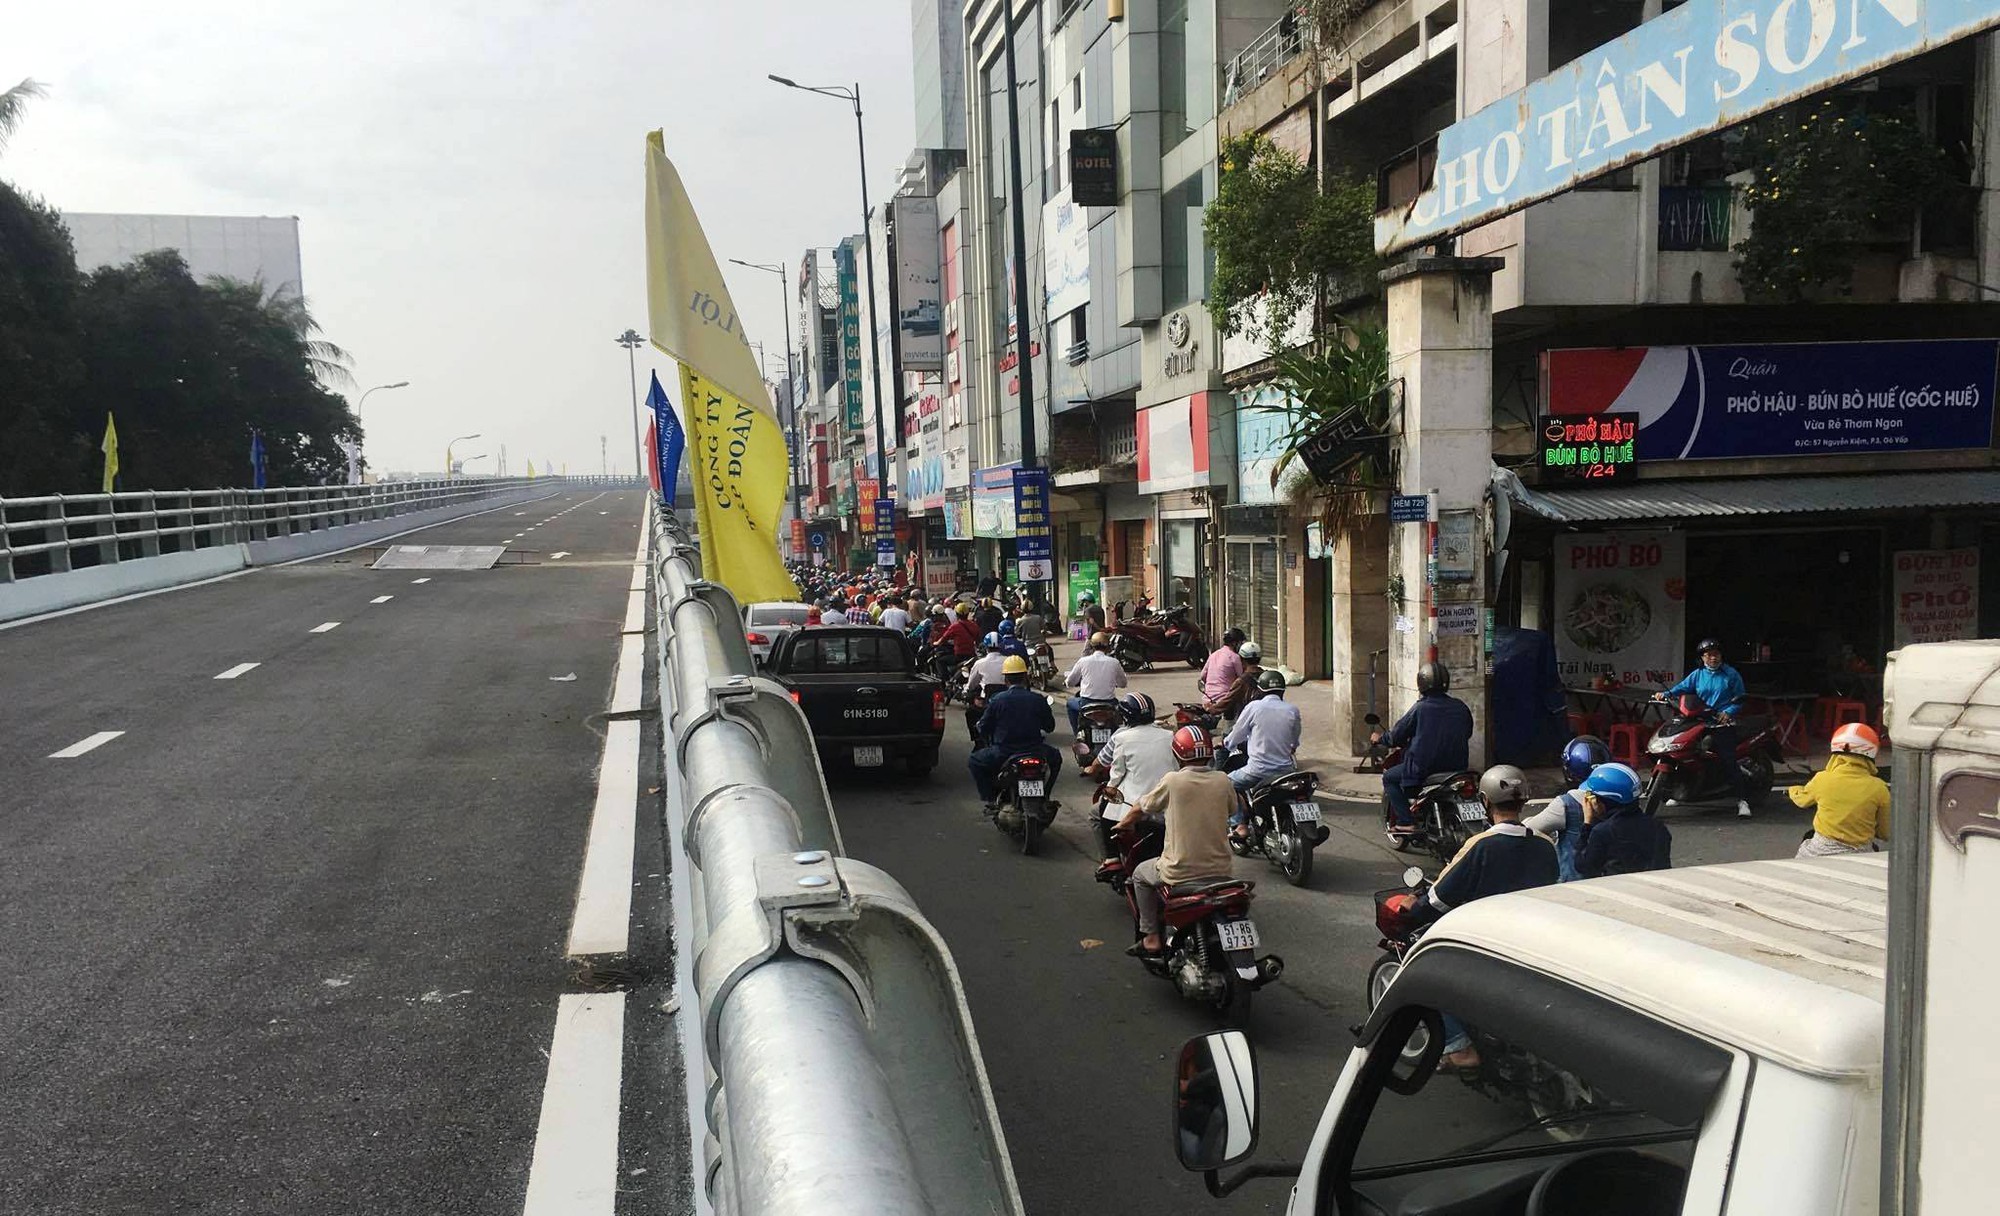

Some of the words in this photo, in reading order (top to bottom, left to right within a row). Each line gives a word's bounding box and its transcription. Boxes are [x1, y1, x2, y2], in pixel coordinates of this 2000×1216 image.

[1538, 46, 1694, 172] TÂN
[1075, 157, 1112, 169] HOTEL
[1728, 357, 1778, 380] Quán
[707, 391, 722, 426] TY
[1727, 390, 1761, 413] PHỞ
[1764, 391, 1796, 416] HẬU
[1808, 389, 1838, 410] BÚN
[1842, 388, 1863, 409] BÒ
[1867, 385, 1899, 408] HUẾ
[1900, 384, 1941, 409] (GỐC
[1944, 383, 1980, 408] HUẾ)
[1565, 416, 1597, 442] PHỞ
[1600, 418, 1634, 444] HẬU
[1804, 420, 1825, 430] Vừa
[1875, 418, 1904, 430] Ngon
[727, 403, 754, 478] ĐOÀN
[1305, 419, 1364, 461] HOTEL
[1546, 443, 1577, 465] BÚN
[1580, 442, 1600, 464] BÒ
[1604, 438, 1634, 463] HUẾ
[708, 436, 731, 509] CÔNG
[1570, 536, 1620, 569] PHỞ
[844, 709, 889, 719] 61N-5180
[1223, 923, 1251, 936] 51-R6
[1226, 934, 1255, 949] 9733
